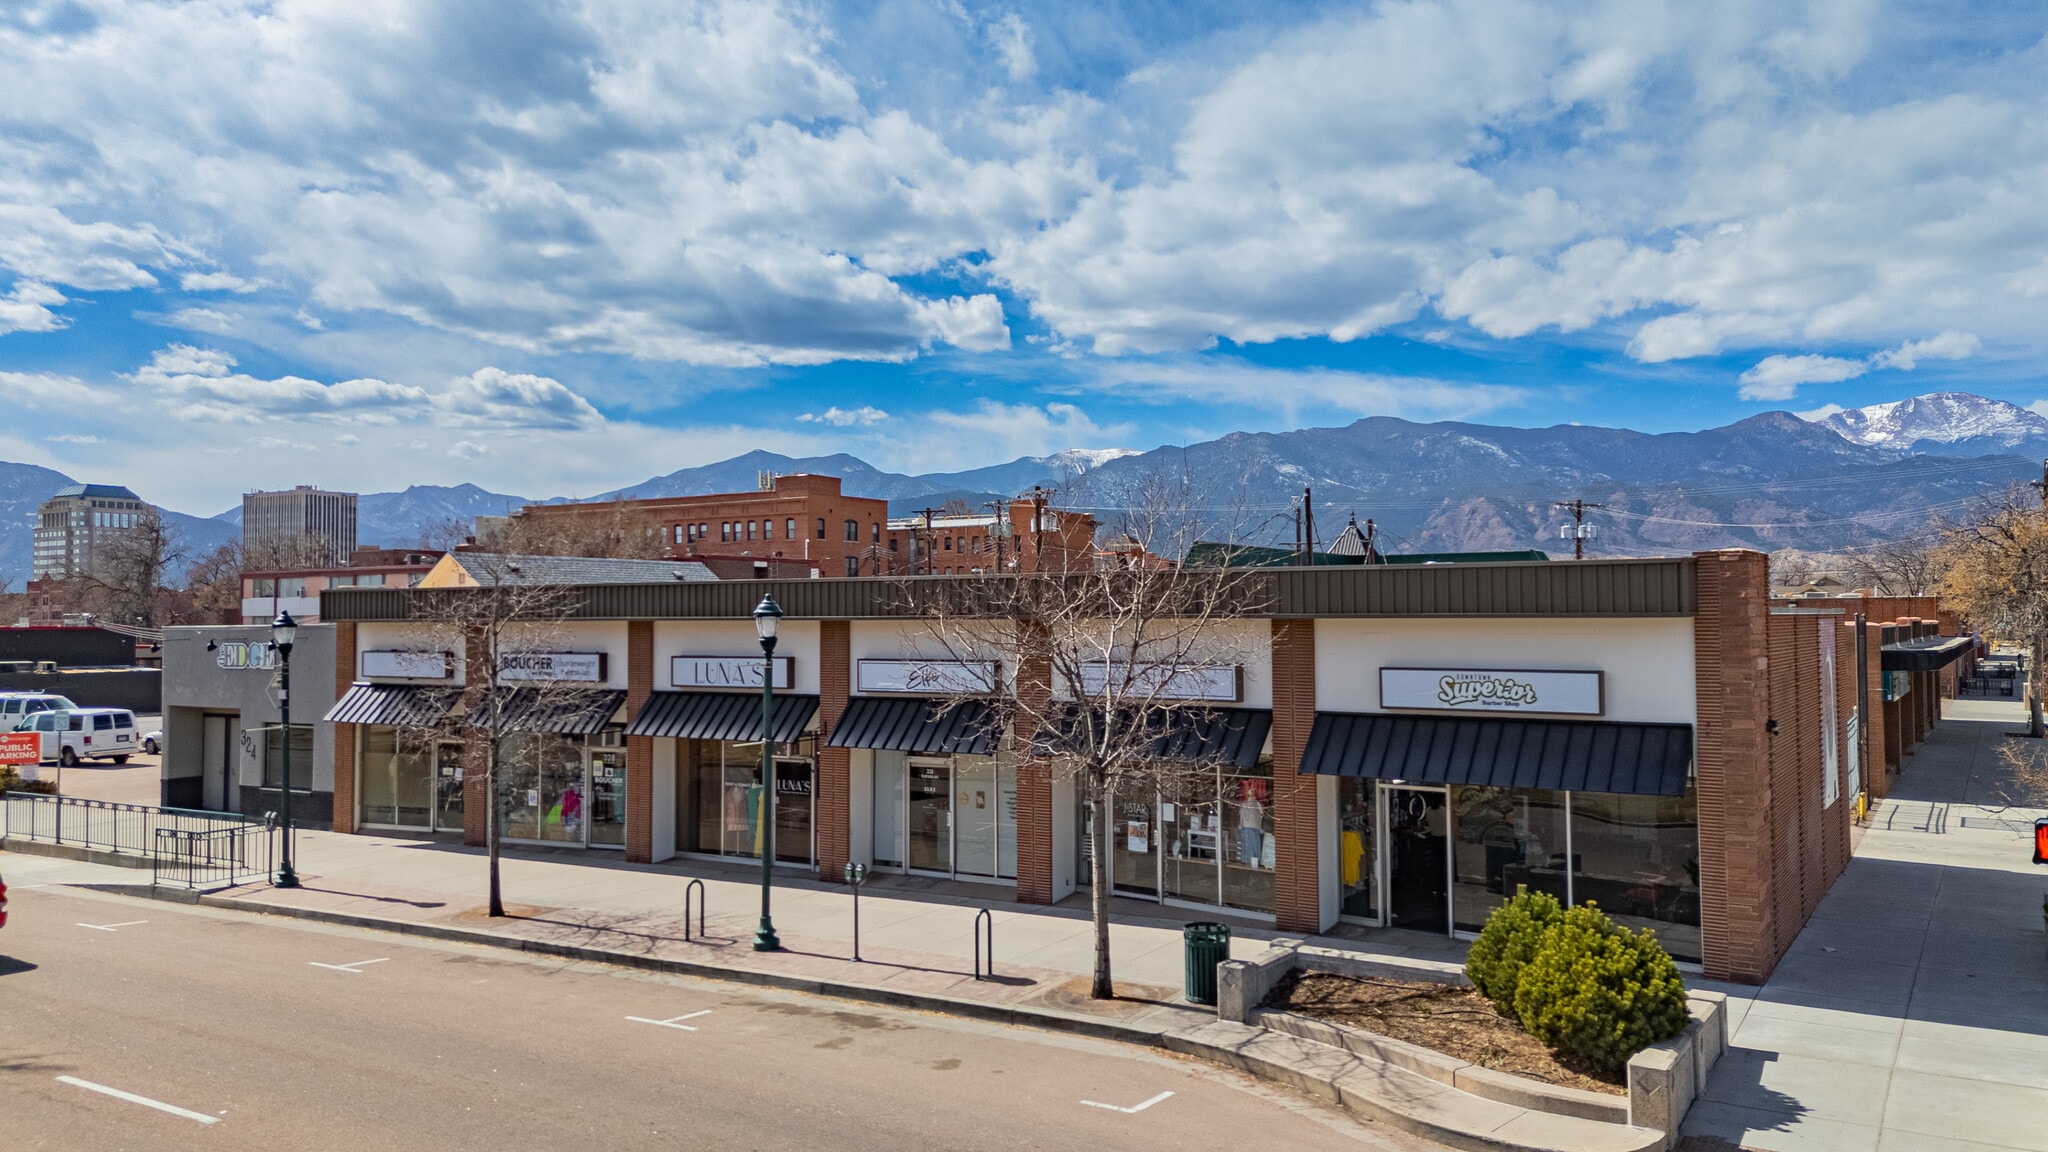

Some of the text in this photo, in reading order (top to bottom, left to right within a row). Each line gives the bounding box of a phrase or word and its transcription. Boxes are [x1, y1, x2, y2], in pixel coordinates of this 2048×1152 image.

[503, 657, 553, 669] BOUCHER
[695, 662, 764, 685] LUNA'S
[1438, 675, 1537, 706] Superior
[0, 743, 33, 752] PUBLIC
[0, 751, 37, 760] ARKING
[777, 779, 811, 792] LUNA'S
